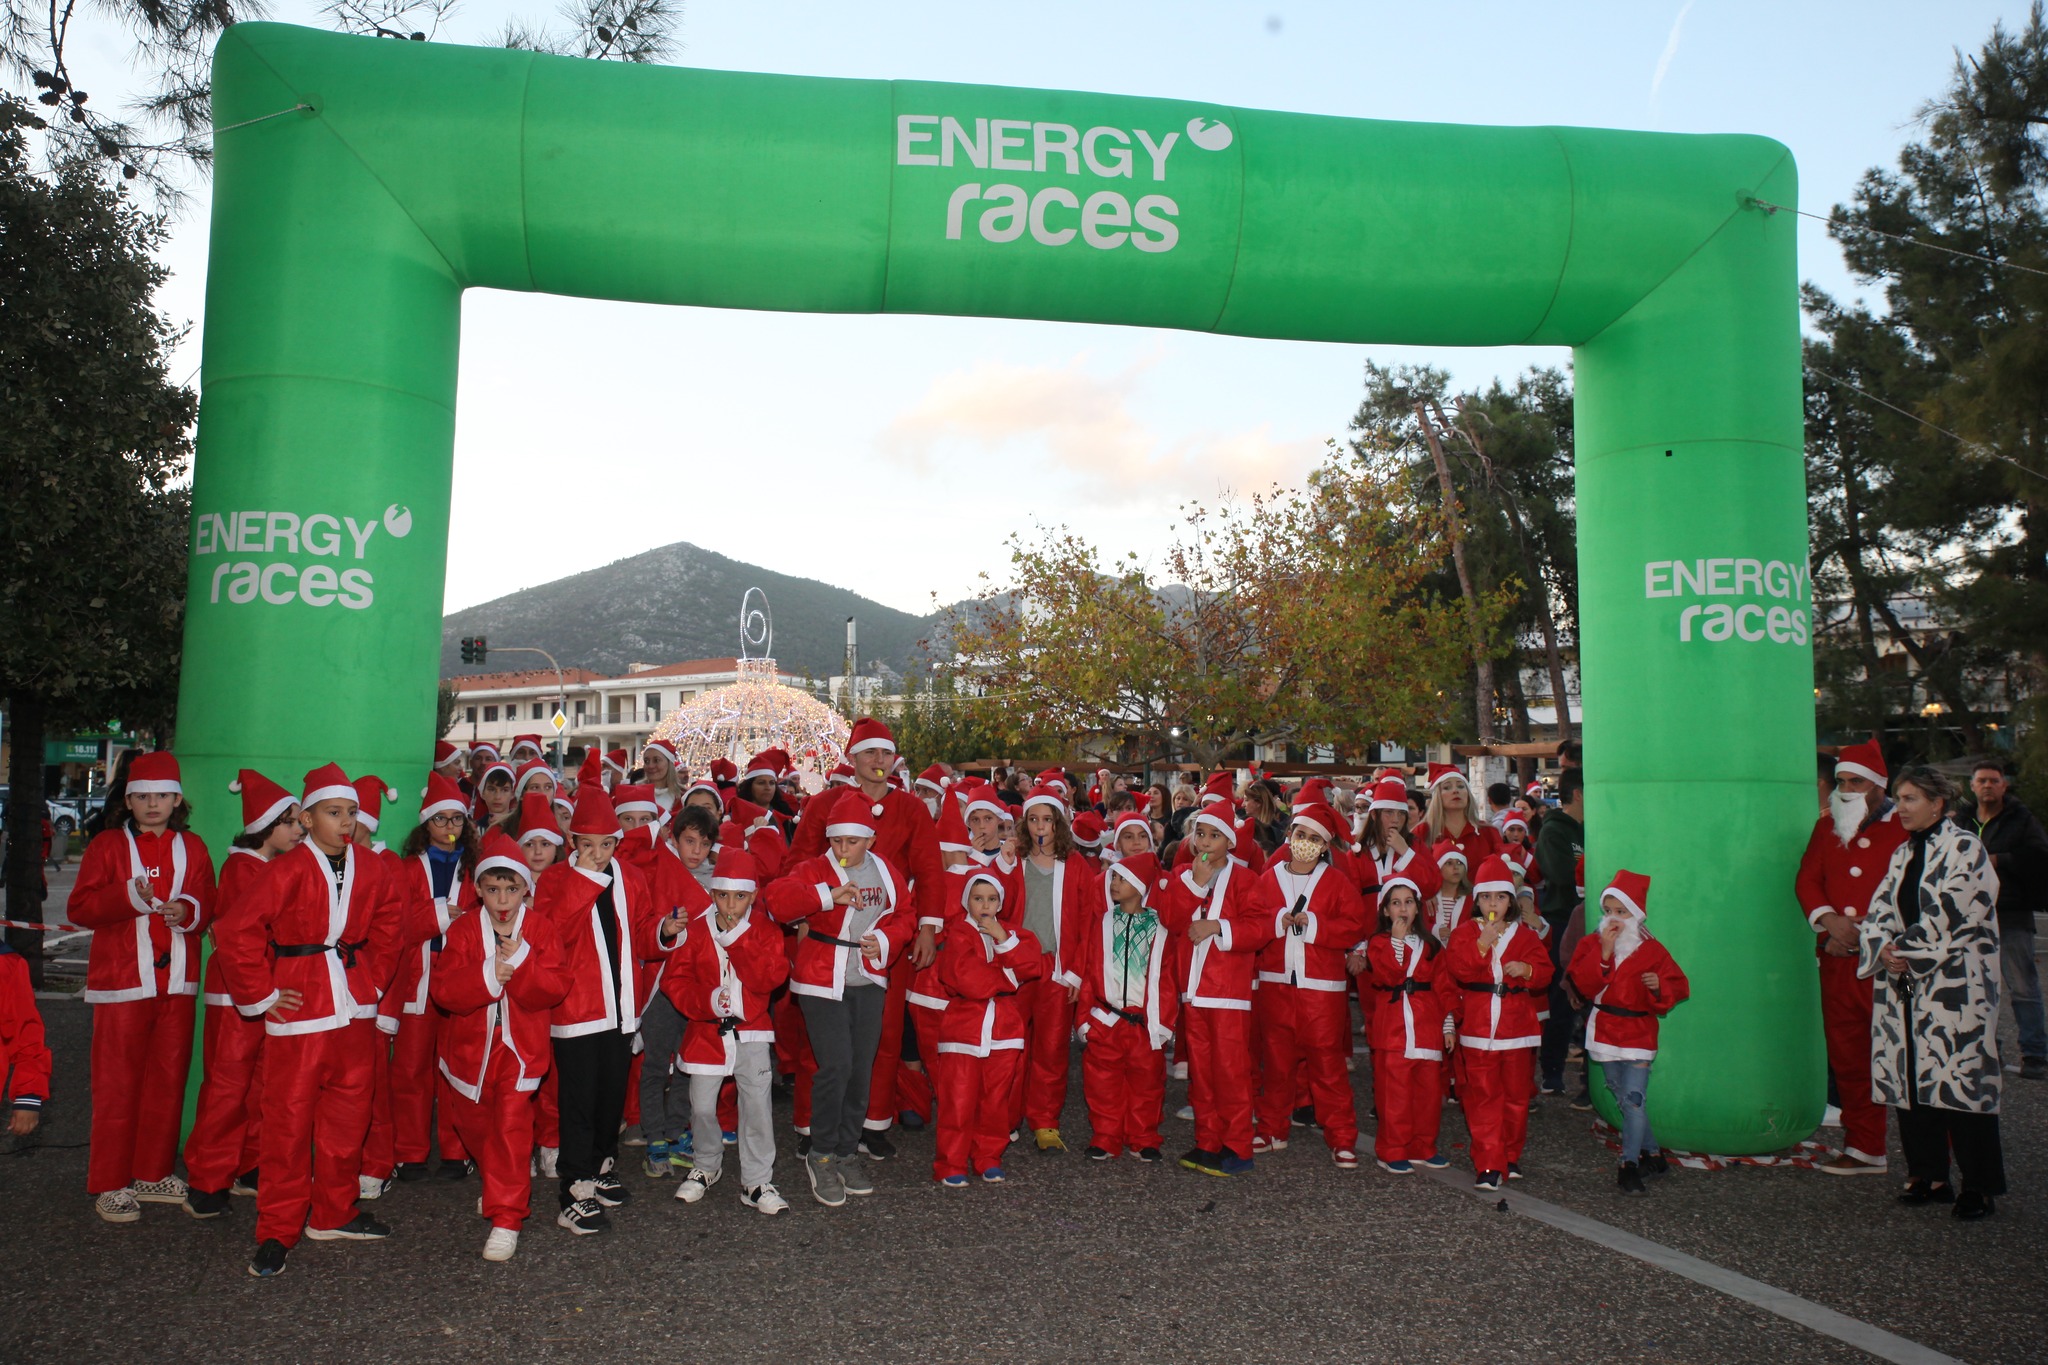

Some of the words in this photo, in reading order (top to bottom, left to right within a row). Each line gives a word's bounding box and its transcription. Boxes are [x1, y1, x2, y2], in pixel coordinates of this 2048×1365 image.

[897, 114, 1181, 182] ENERGY
[945, 182, 1180, 253] races
[195, 511, 380, 561] ENERGY
[211, 562, 374, 610] races
[1645, 558, 1806, 601] ENERGY
[1680, 604, 1808, 646] races
